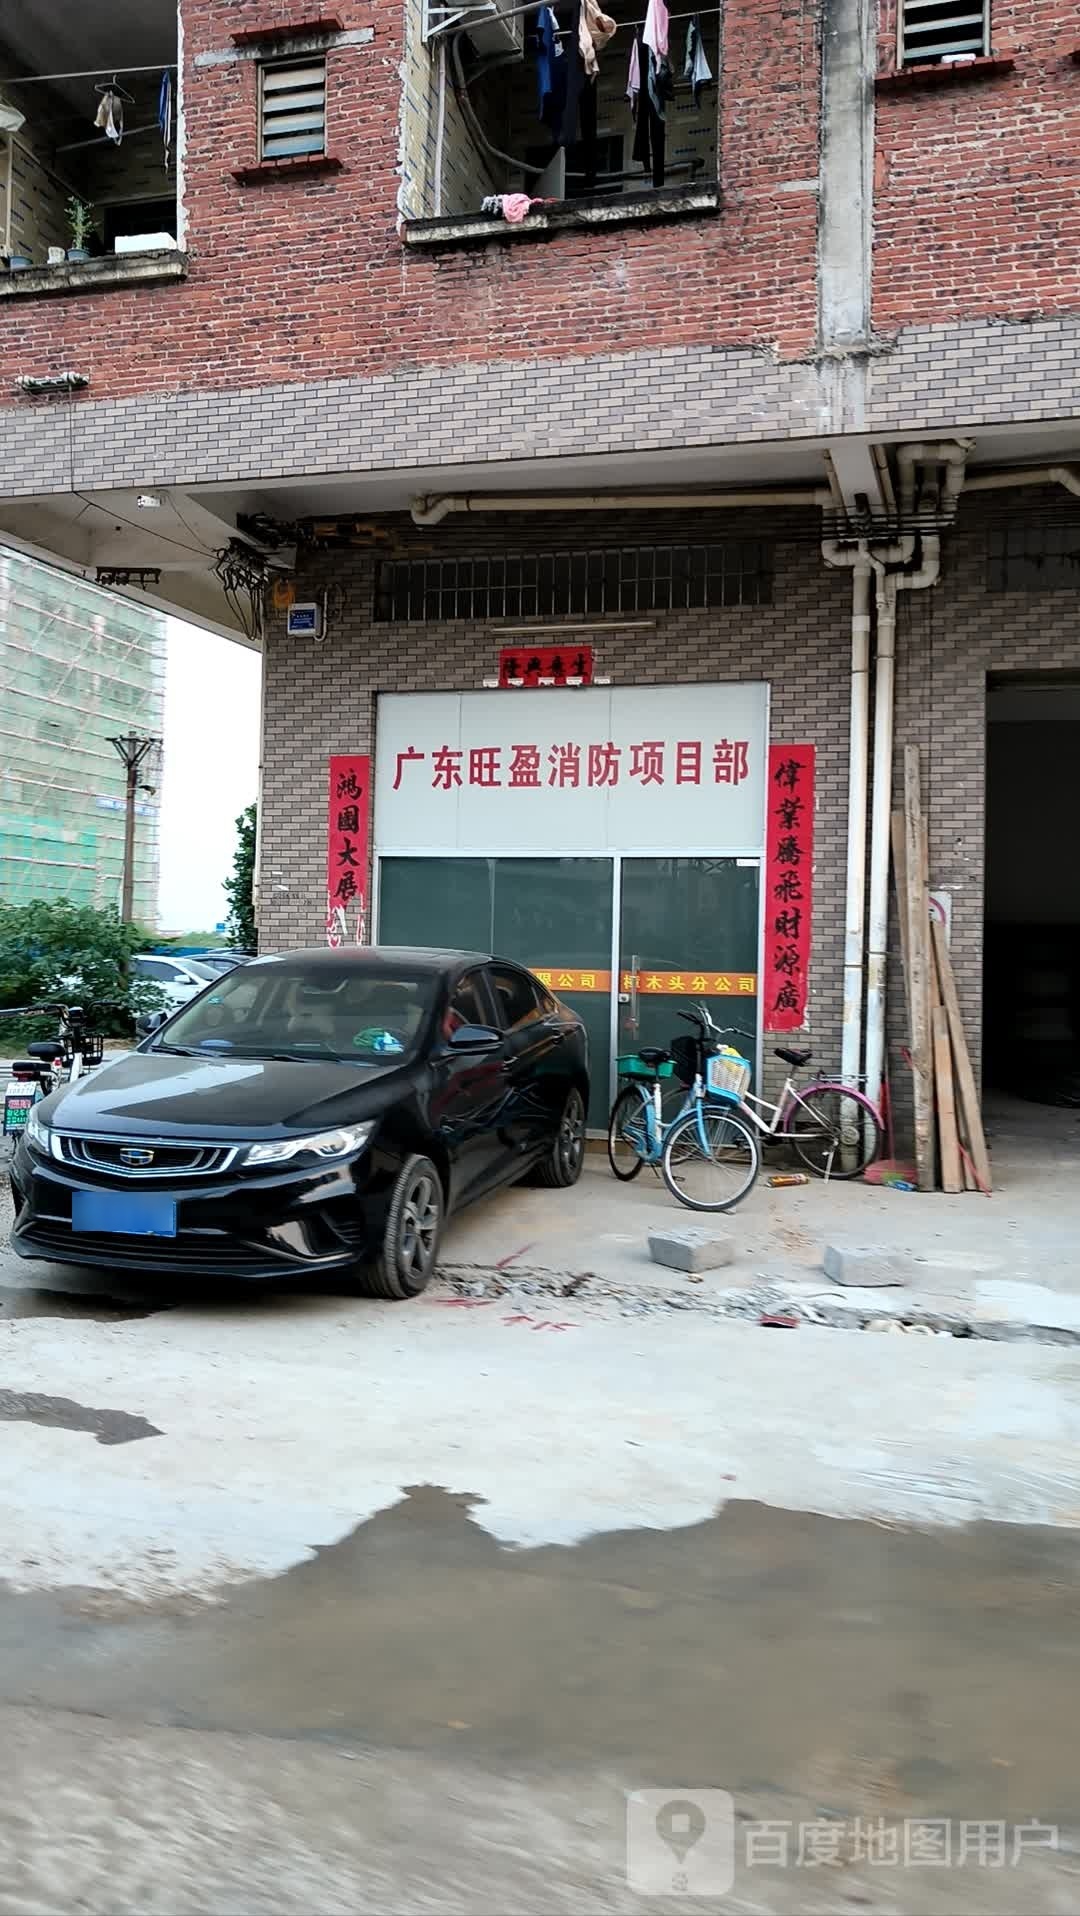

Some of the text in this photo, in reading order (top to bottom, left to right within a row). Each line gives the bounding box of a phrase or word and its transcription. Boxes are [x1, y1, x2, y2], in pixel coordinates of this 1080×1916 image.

[392, 738, 751, 790] 广东旺盈消防项目部
